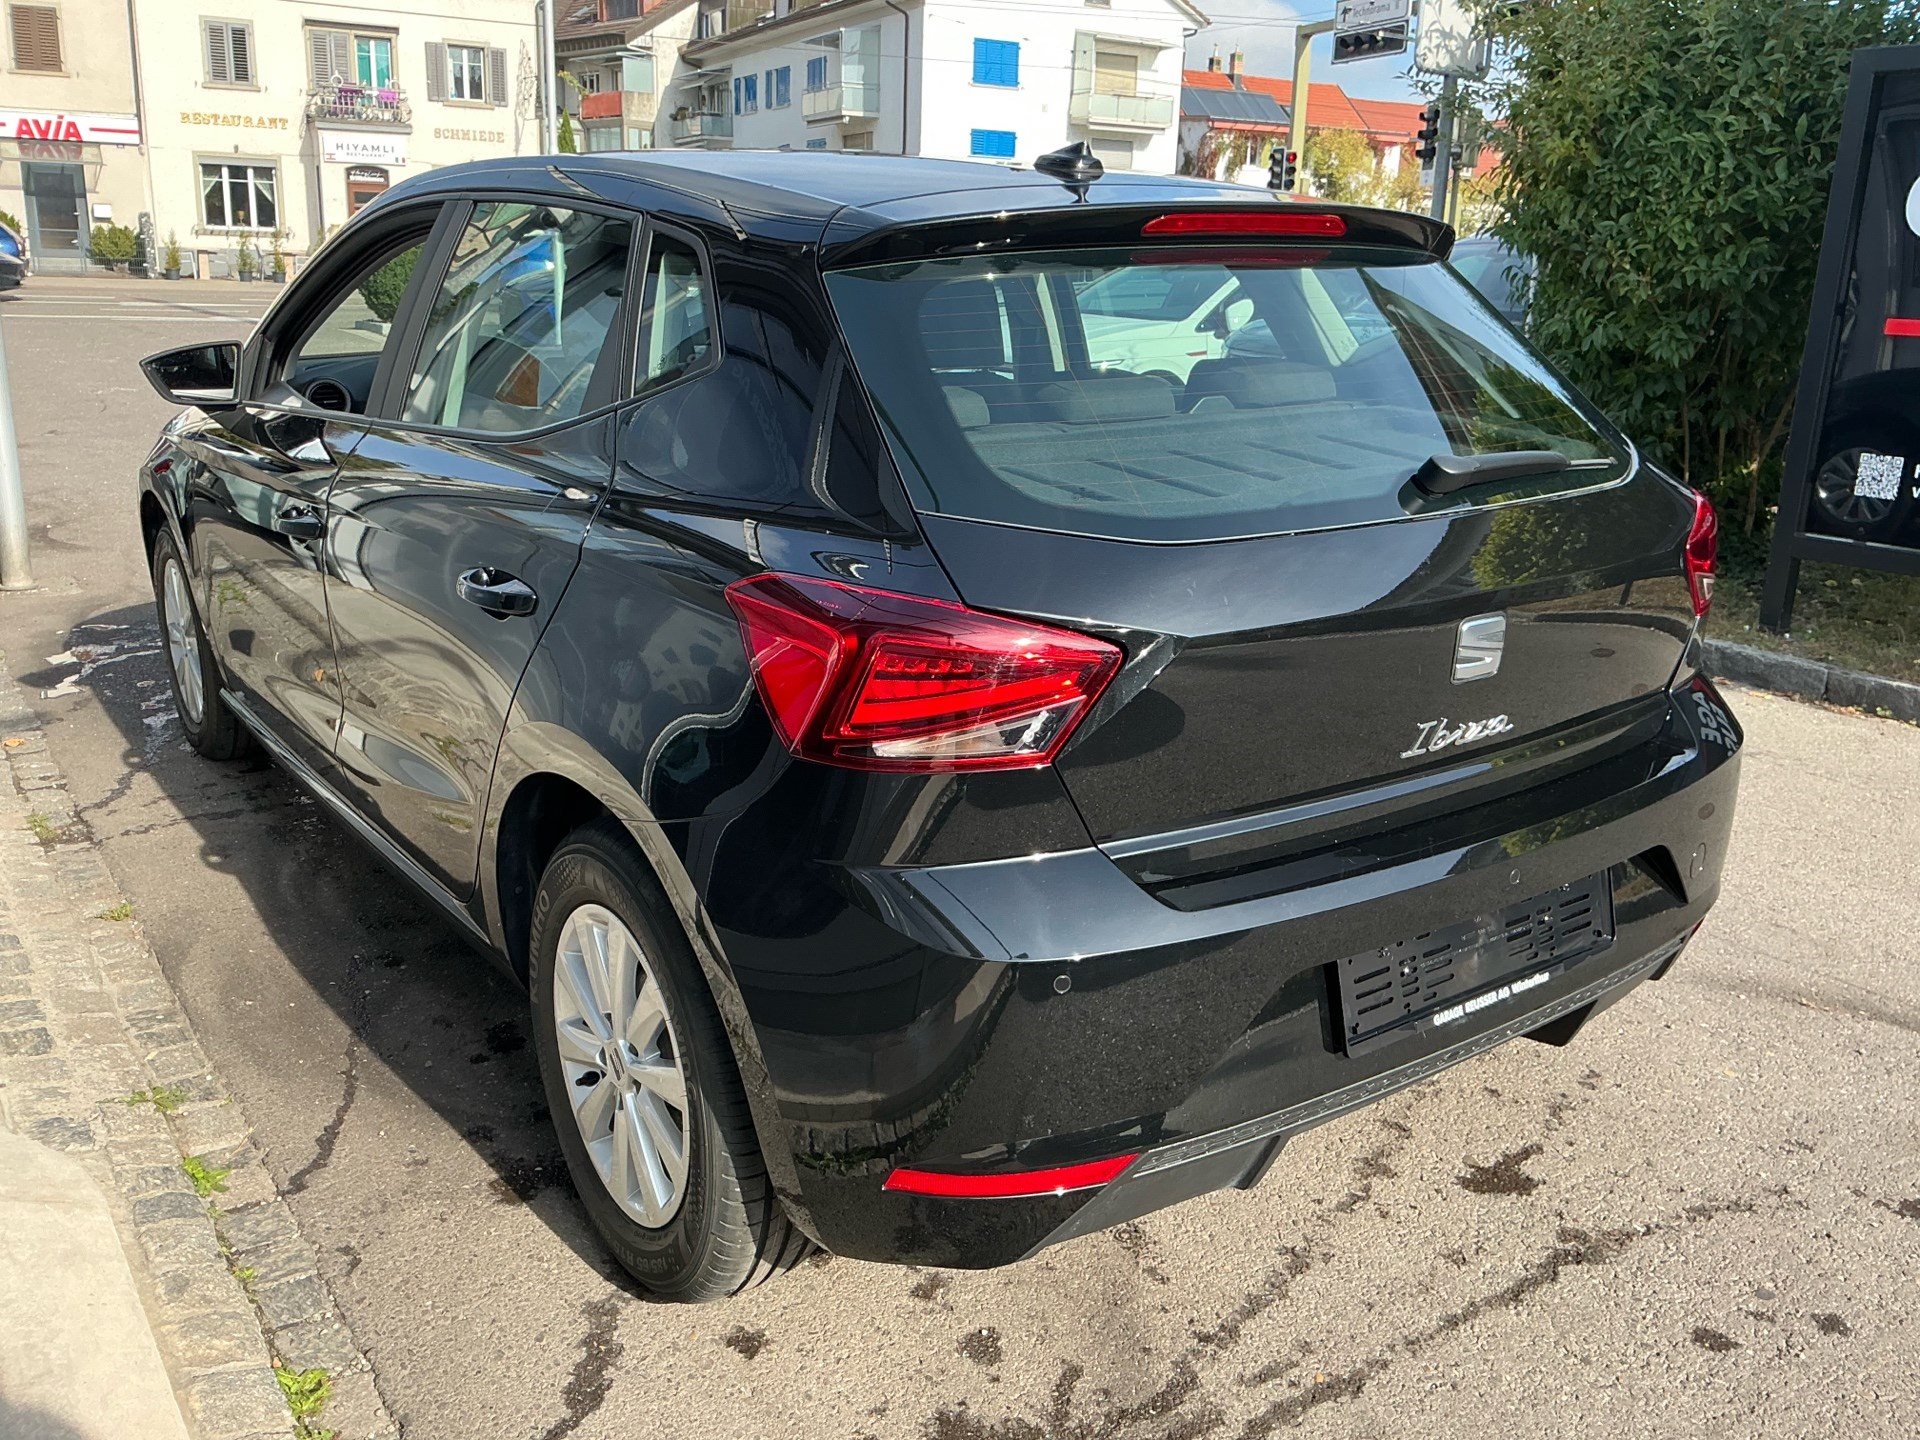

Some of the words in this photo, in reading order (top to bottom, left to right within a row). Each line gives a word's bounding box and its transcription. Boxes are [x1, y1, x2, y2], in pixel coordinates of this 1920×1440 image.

[180, 112, 289, 130] RESTAURANT
[434, 127, 505, 144] SCHMIEDE
[336, 142, 395, 154] HIYAMLI
[1400, 714, 1515, 759] Ibiza
[529, 889, 550, 1005] KUMHO
[1498, 986, 1511, 1001] AG
